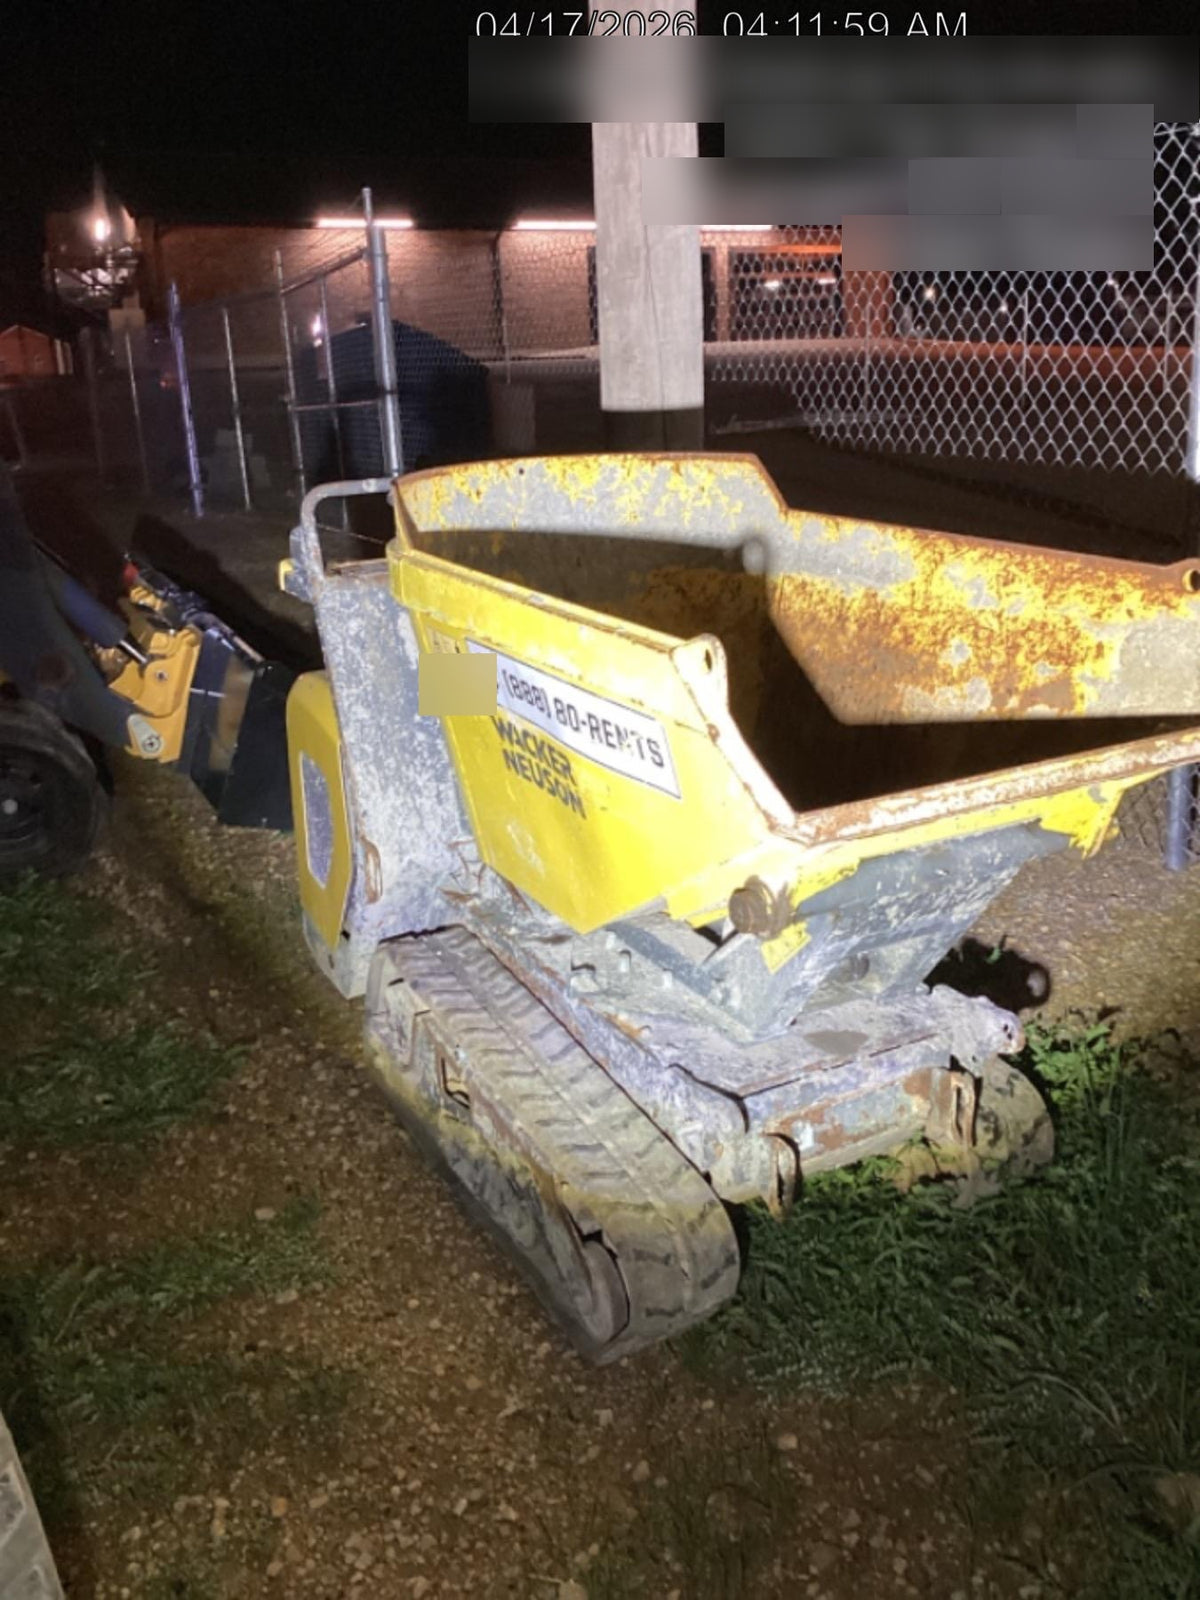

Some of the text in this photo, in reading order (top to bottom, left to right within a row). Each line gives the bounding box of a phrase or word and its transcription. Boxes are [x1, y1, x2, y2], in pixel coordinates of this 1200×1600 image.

[502, 669, 552, 718] (888)
[490, 715, 578, 786] WACKER
[502, 748, 587, 820] NEUSON
